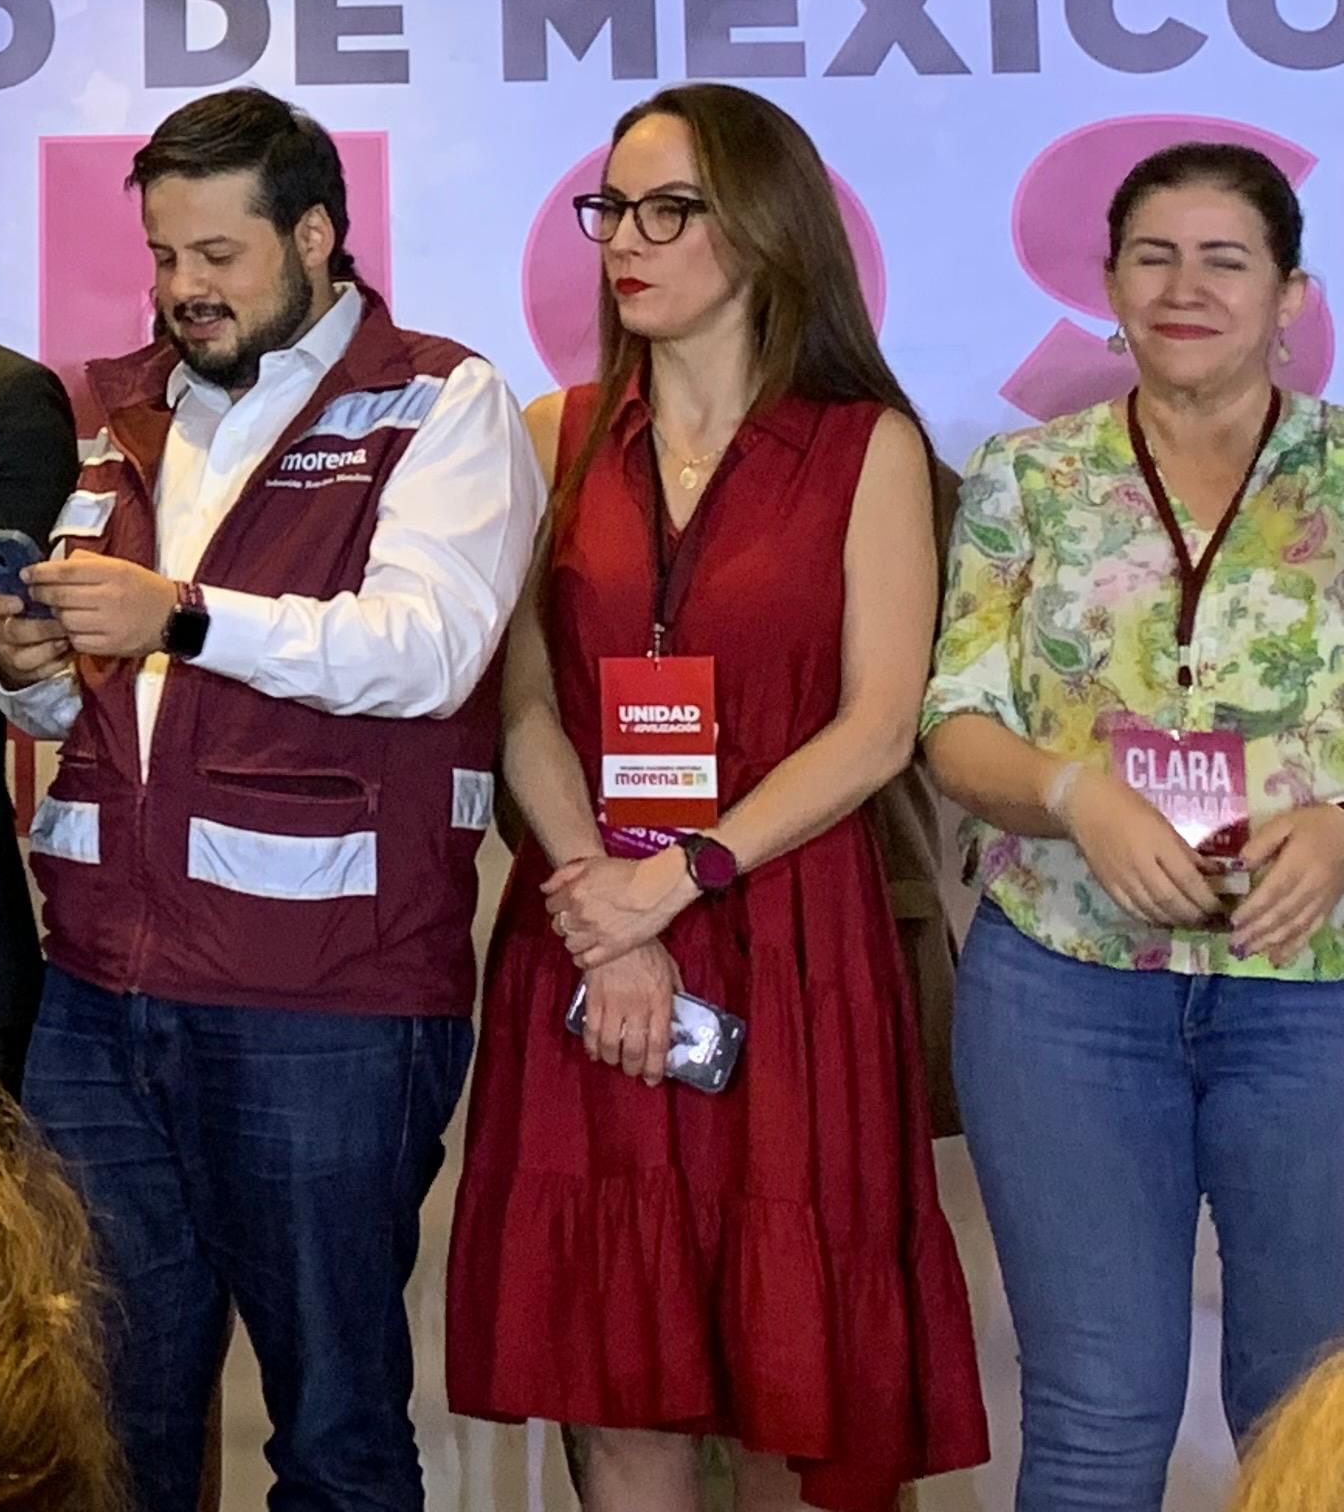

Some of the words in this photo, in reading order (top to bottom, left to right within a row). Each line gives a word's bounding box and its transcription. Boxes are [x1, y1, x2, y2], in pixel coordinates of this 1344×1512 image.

[280, 448, 367, 471] morena
[618, 705, 701, 723] UNIDAD
[615, 773, 678, 785] morena
[1126, 747, 1233, 793] CLARA
